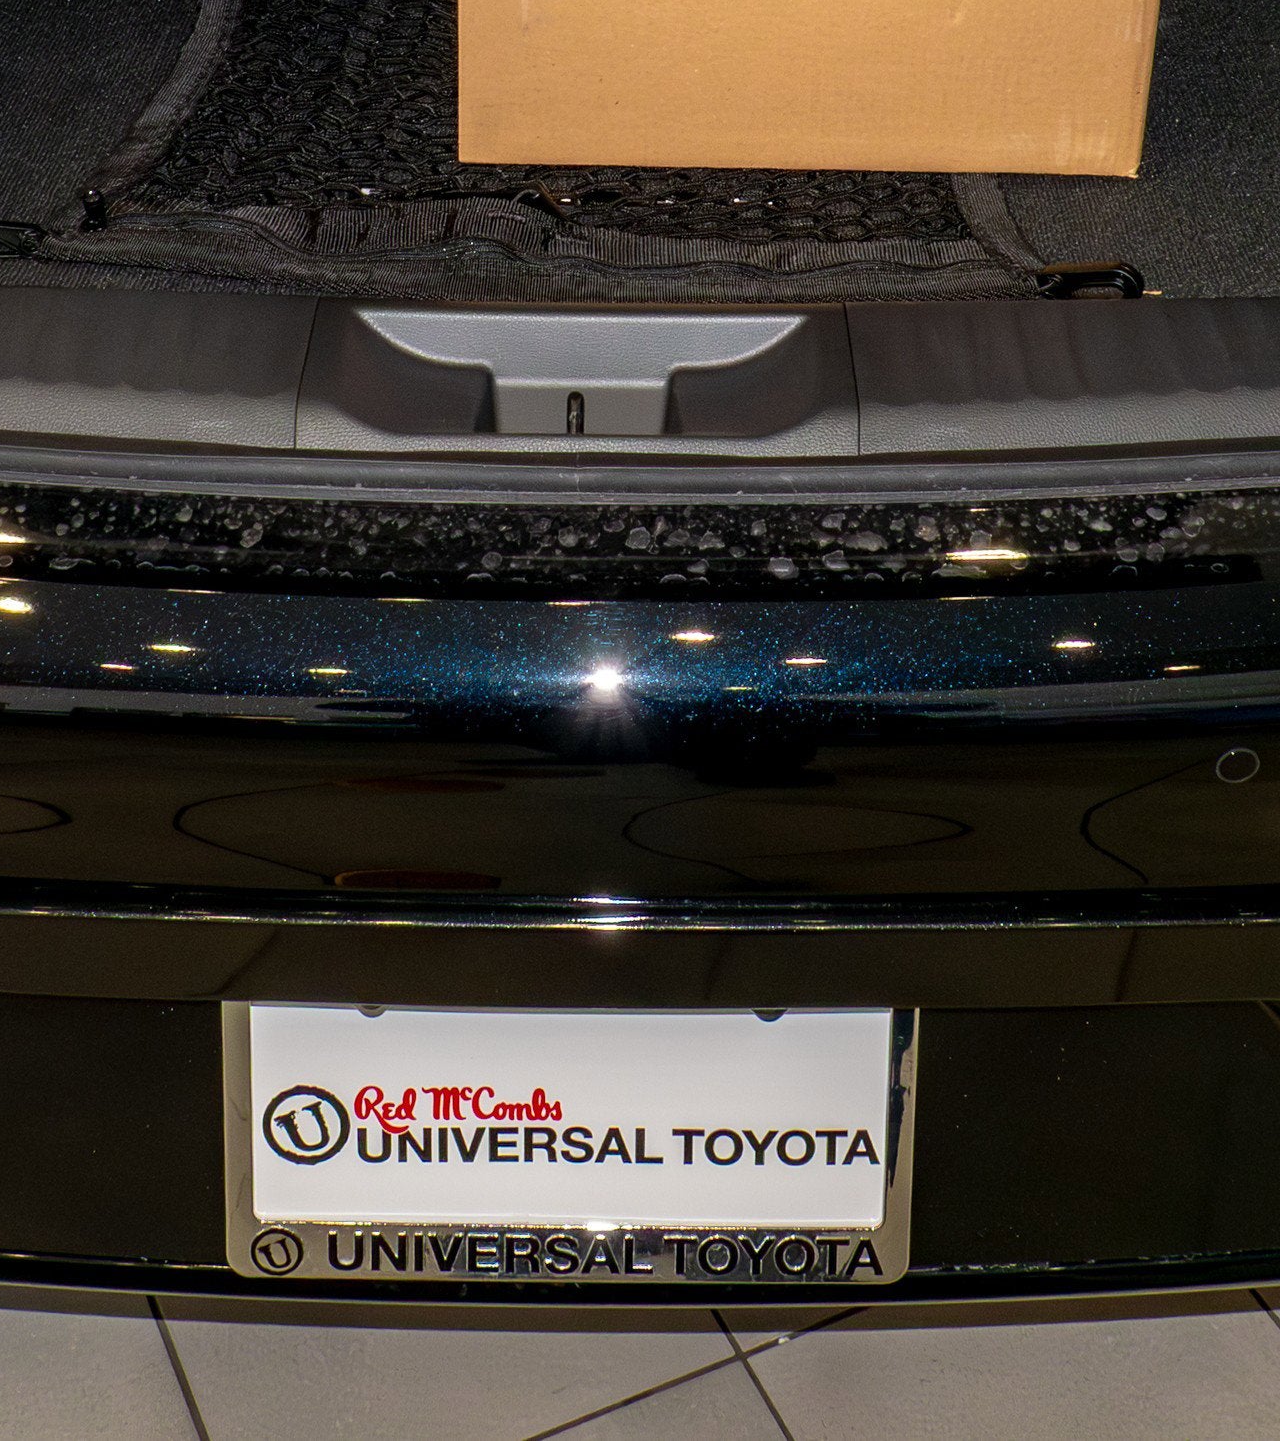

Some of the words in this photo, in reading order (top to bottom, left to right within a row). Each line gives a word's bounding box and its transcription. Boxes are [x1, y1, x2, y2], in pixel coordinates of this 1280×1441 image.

[353, 1084, 418, 1134] Red
[422, 1086, 563, 1122] McCombs
[357, 1126, 664, 1165] UNIVERSAL
[672, 1128, 880, 1166] TOYOTA
[327, 1230, 653, 1276] UNIVERSAL
[665, 1236, 884, 1277] TOYOTA
